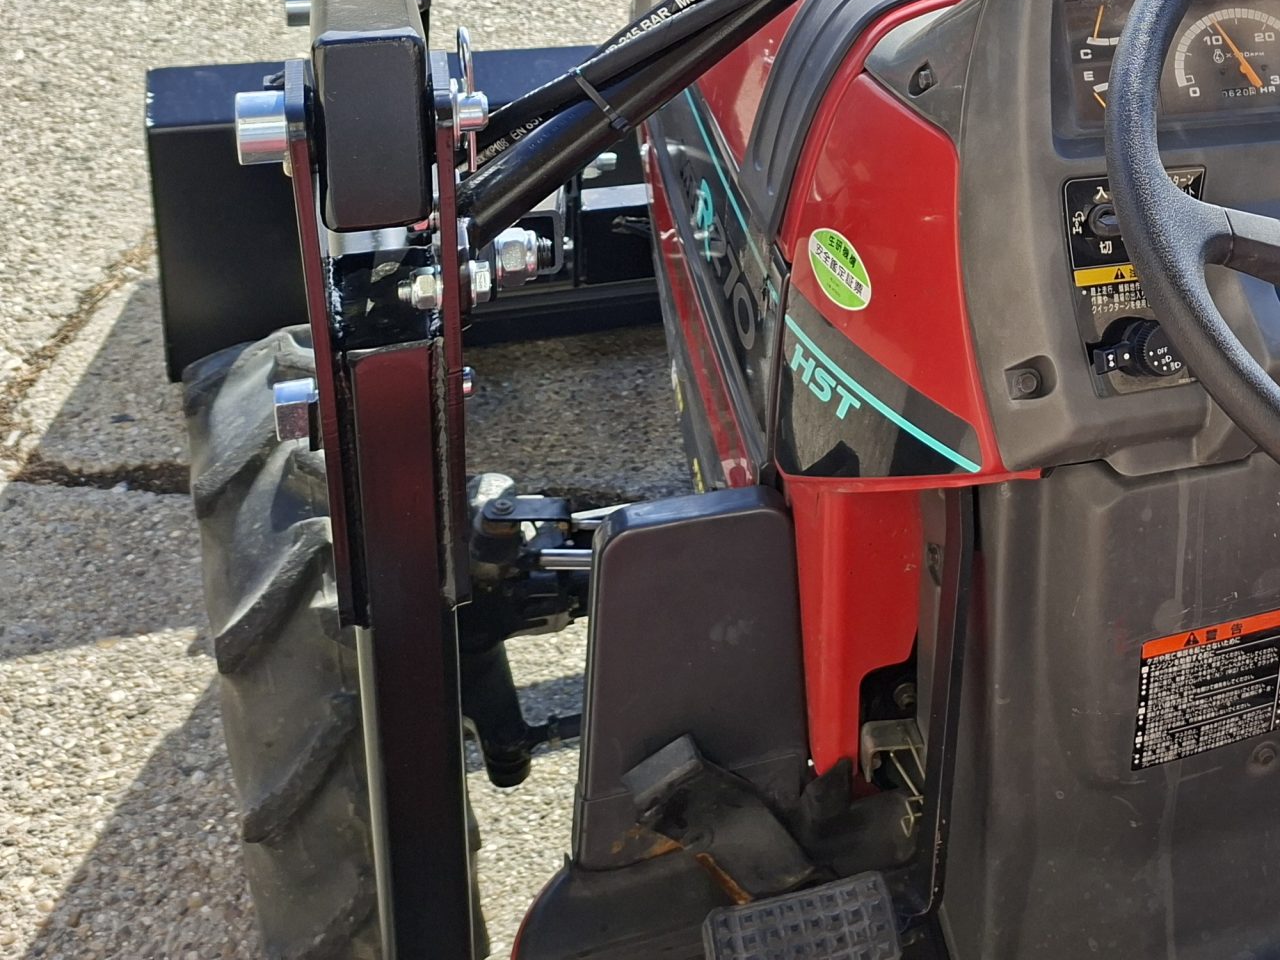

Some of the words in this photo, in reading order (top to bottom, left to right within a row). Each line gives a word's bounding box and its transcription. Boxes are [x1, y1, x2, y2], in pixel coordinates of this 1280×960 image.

[641, 7, 672, 32] BAR
[1203, 35, 1222, 46] 10
[1254, 32, 1276, 42] 20
[1080, 49, 1092, 60] C
[1083, 71, 1094, 82] E
[1189, 87, 1200, 97] 0
[486, 138, 510, 157] KP108
[1096, 186, 1108, 200] 入
[1100, 241, 1113, 255] 切
[1157, 346, 1168, 355] OFF
[790, 343, 861, 420] HST
